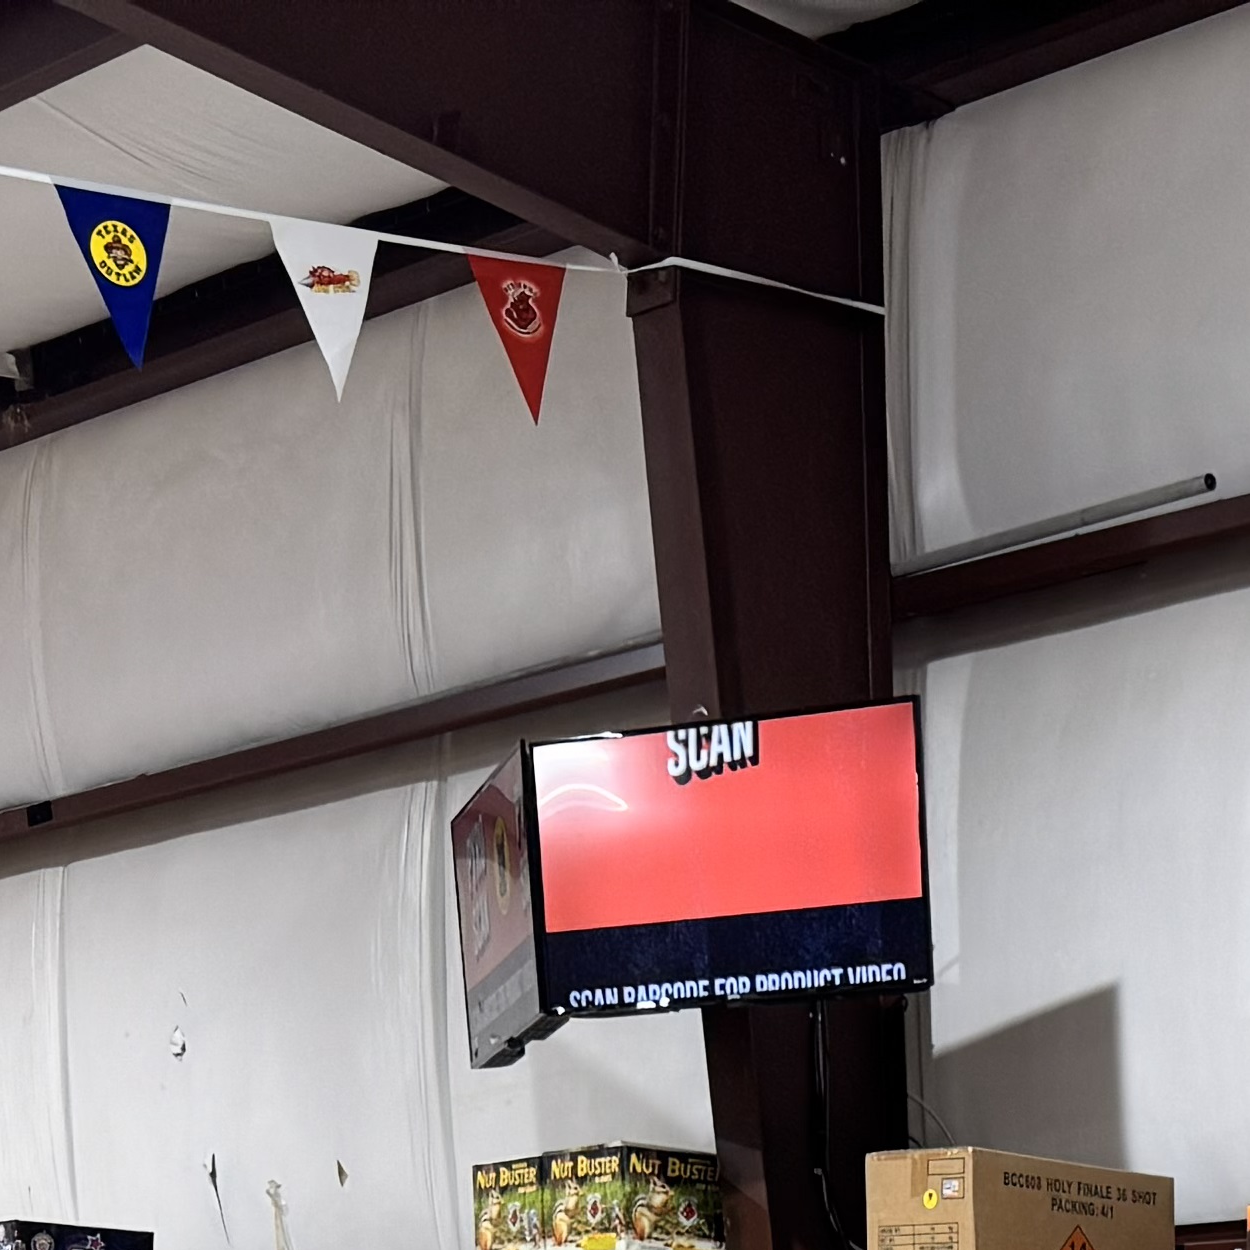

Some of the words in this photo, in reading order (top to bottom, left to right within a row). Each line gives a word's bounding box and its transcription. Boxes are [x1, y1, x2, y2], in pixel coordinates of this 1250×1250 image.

[96, 224, 136, 244] TEXAS
[99, 260, 143, 283] OUTLAW
[666, 721, 757, 780] SCAN
[476, 1169, 497, 1189] NUT
[499, 1166, 538, 1187] BUSTER
[550, 1160, 574, 1180] NUT
[577, 1155, 620, 1177] BUSTER
[628, 1153, 661, 1175] NUT
[666, 1156, 720, 1182] BUSTE
[1046, 1177, 1073, 1194] HOLY
[1077, 1181, 1112, 1200] FINALE
[1117, 1187, 1128, 1202] 36
[1131, 1190, 1157, 1206] SHOT
